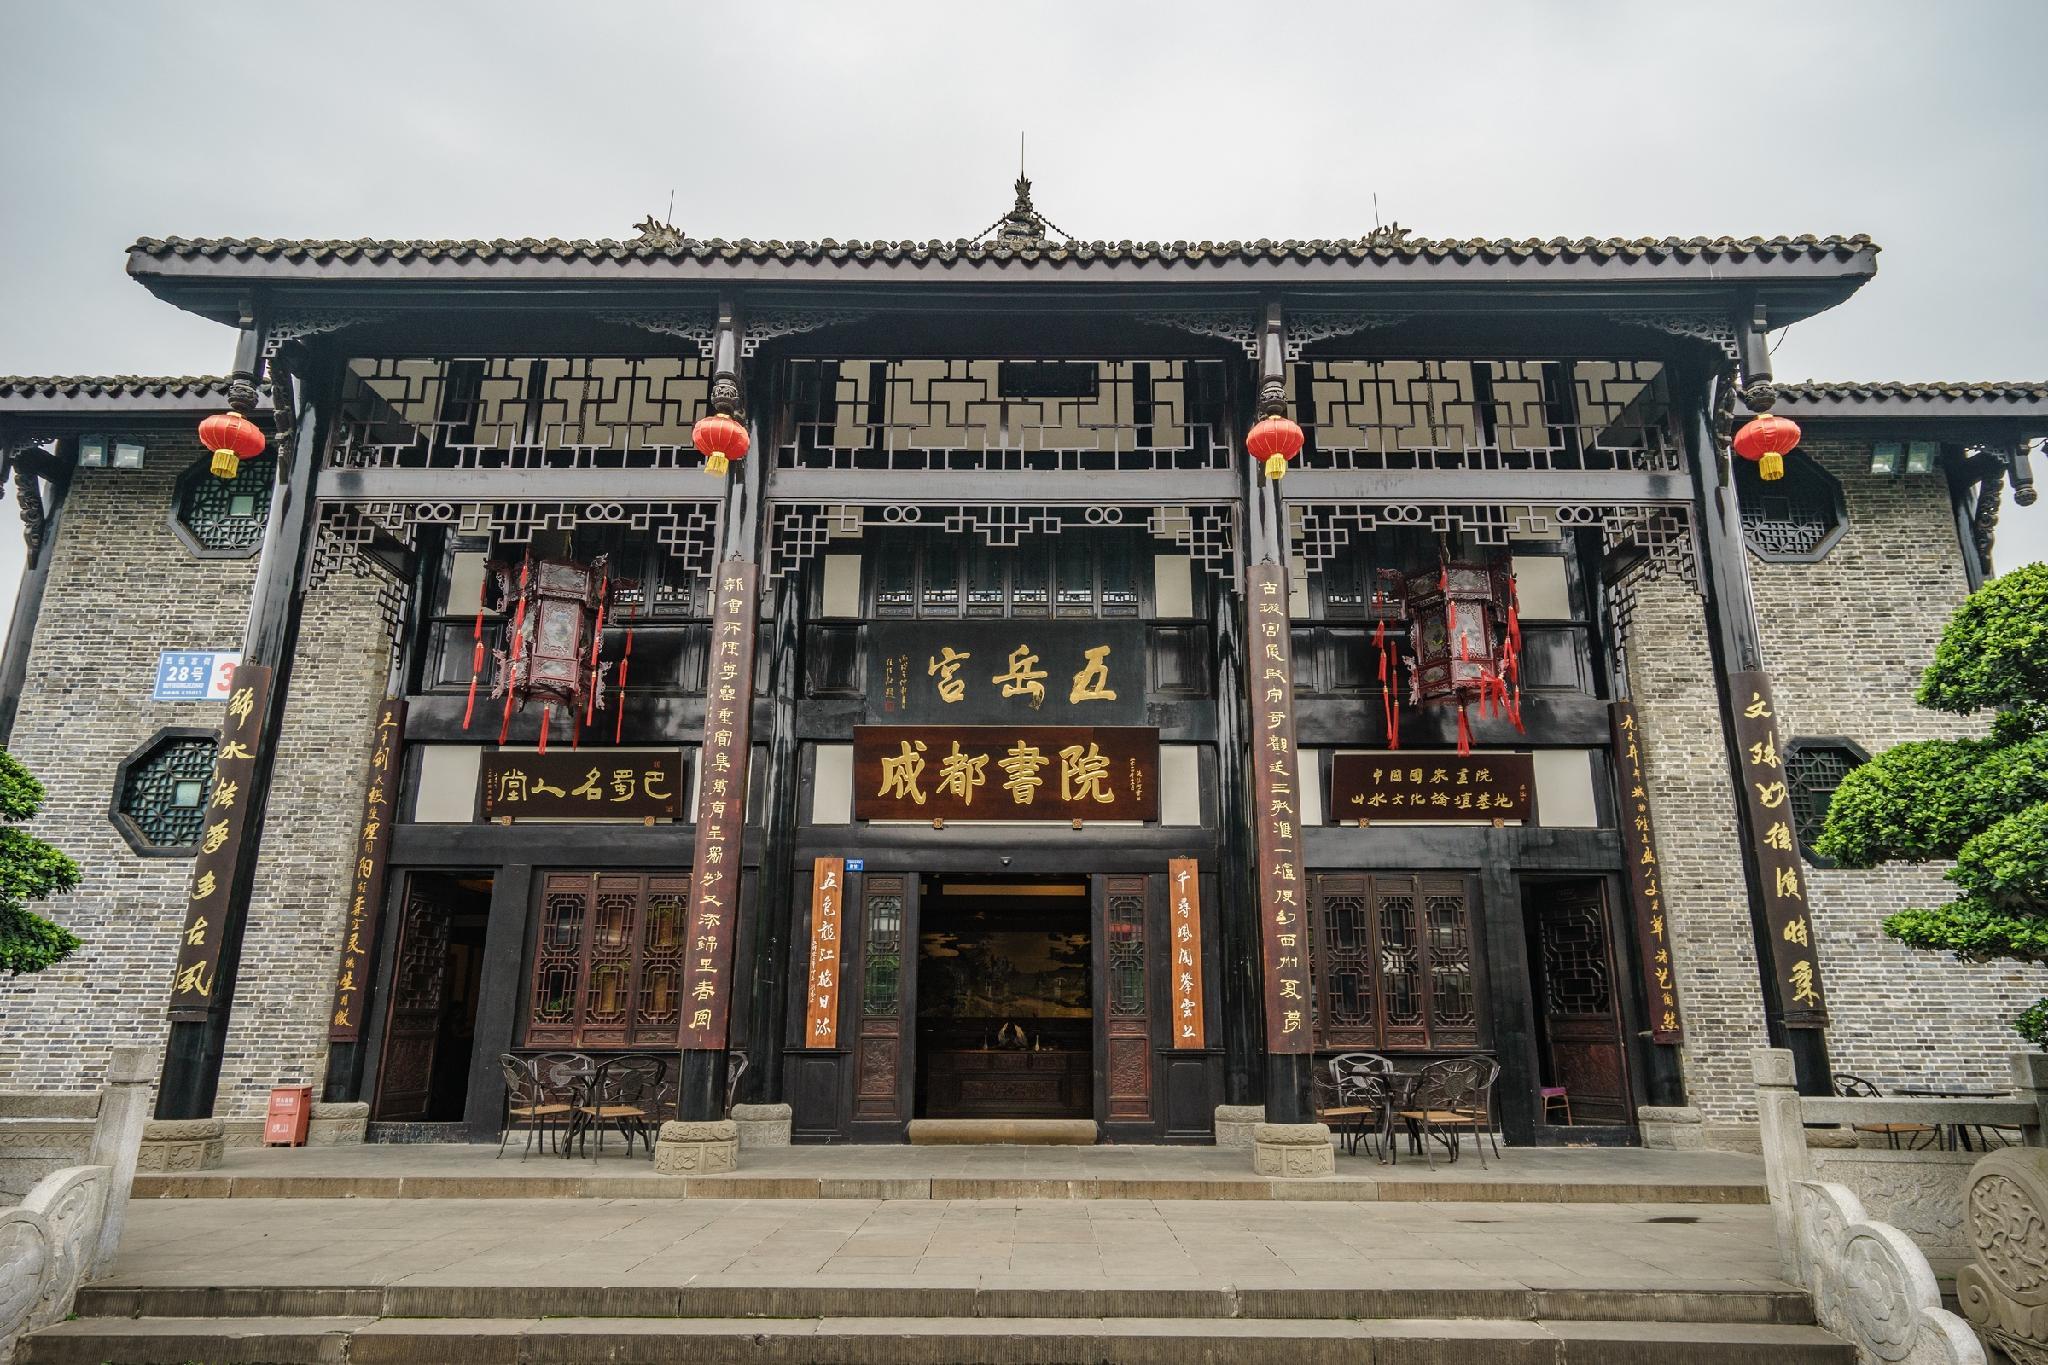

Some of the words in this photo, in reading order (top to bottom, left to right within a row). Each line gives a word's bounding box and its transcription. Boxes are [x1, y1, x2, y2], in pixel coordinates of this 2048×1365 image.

[166, 667, 204, 682] 28号
[498, 767, 672, 802] 巴蜀名人堂
